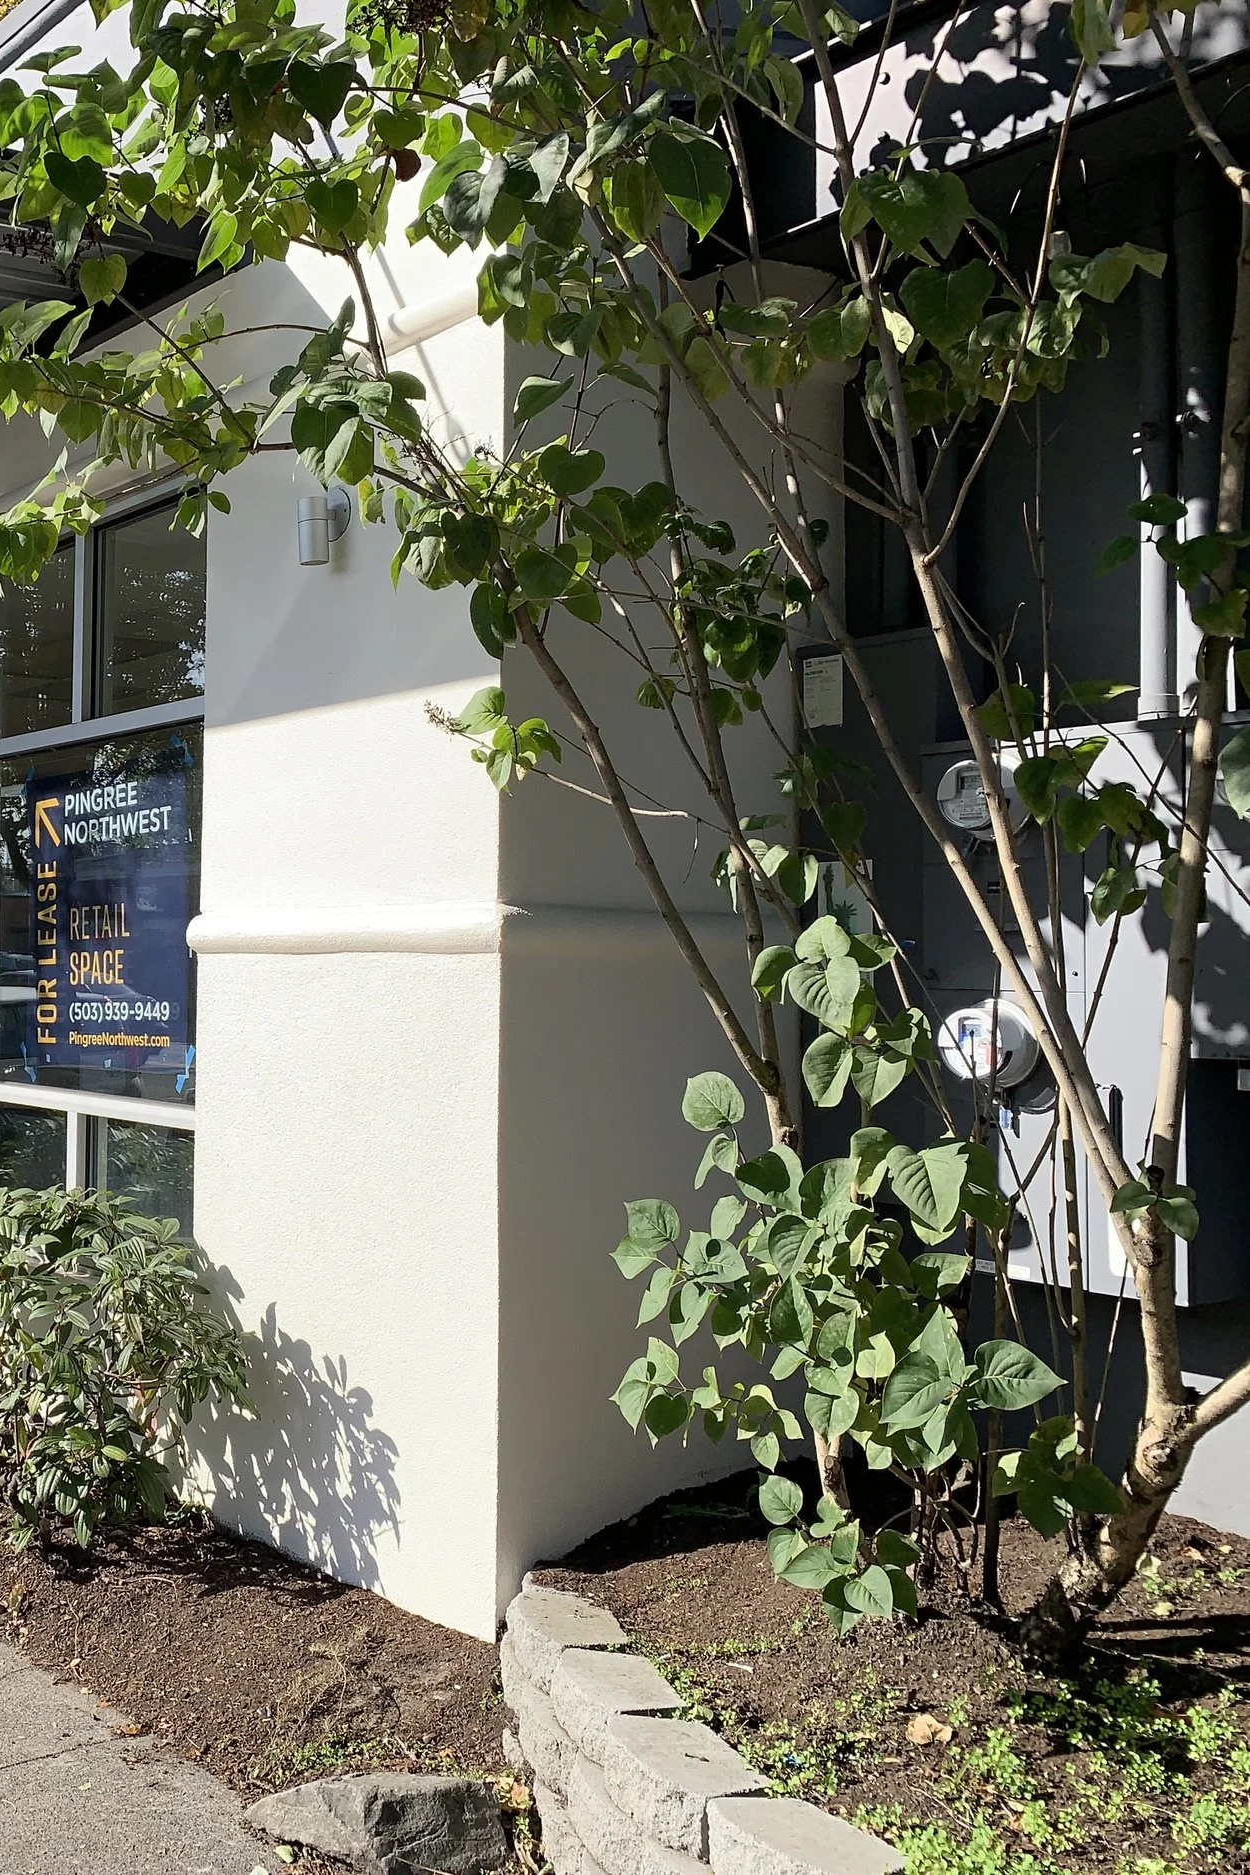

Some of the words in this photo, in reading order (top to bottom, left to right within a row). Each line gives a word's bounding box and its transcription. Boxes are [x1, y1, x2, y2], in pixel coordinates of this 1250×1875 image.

[64, 781, 138, 817] PINGREE
[64, 805, 172, 846] NORTHWEST
[37, 860, 57, 965] LEASE
[69, 902, 130, 941] RETAIL
[69, 949, 125, 987] SPACE
[36, 978, 57, 1044] FOR
[69, 1030, 170, 1048] PingreeNorthwest.com
